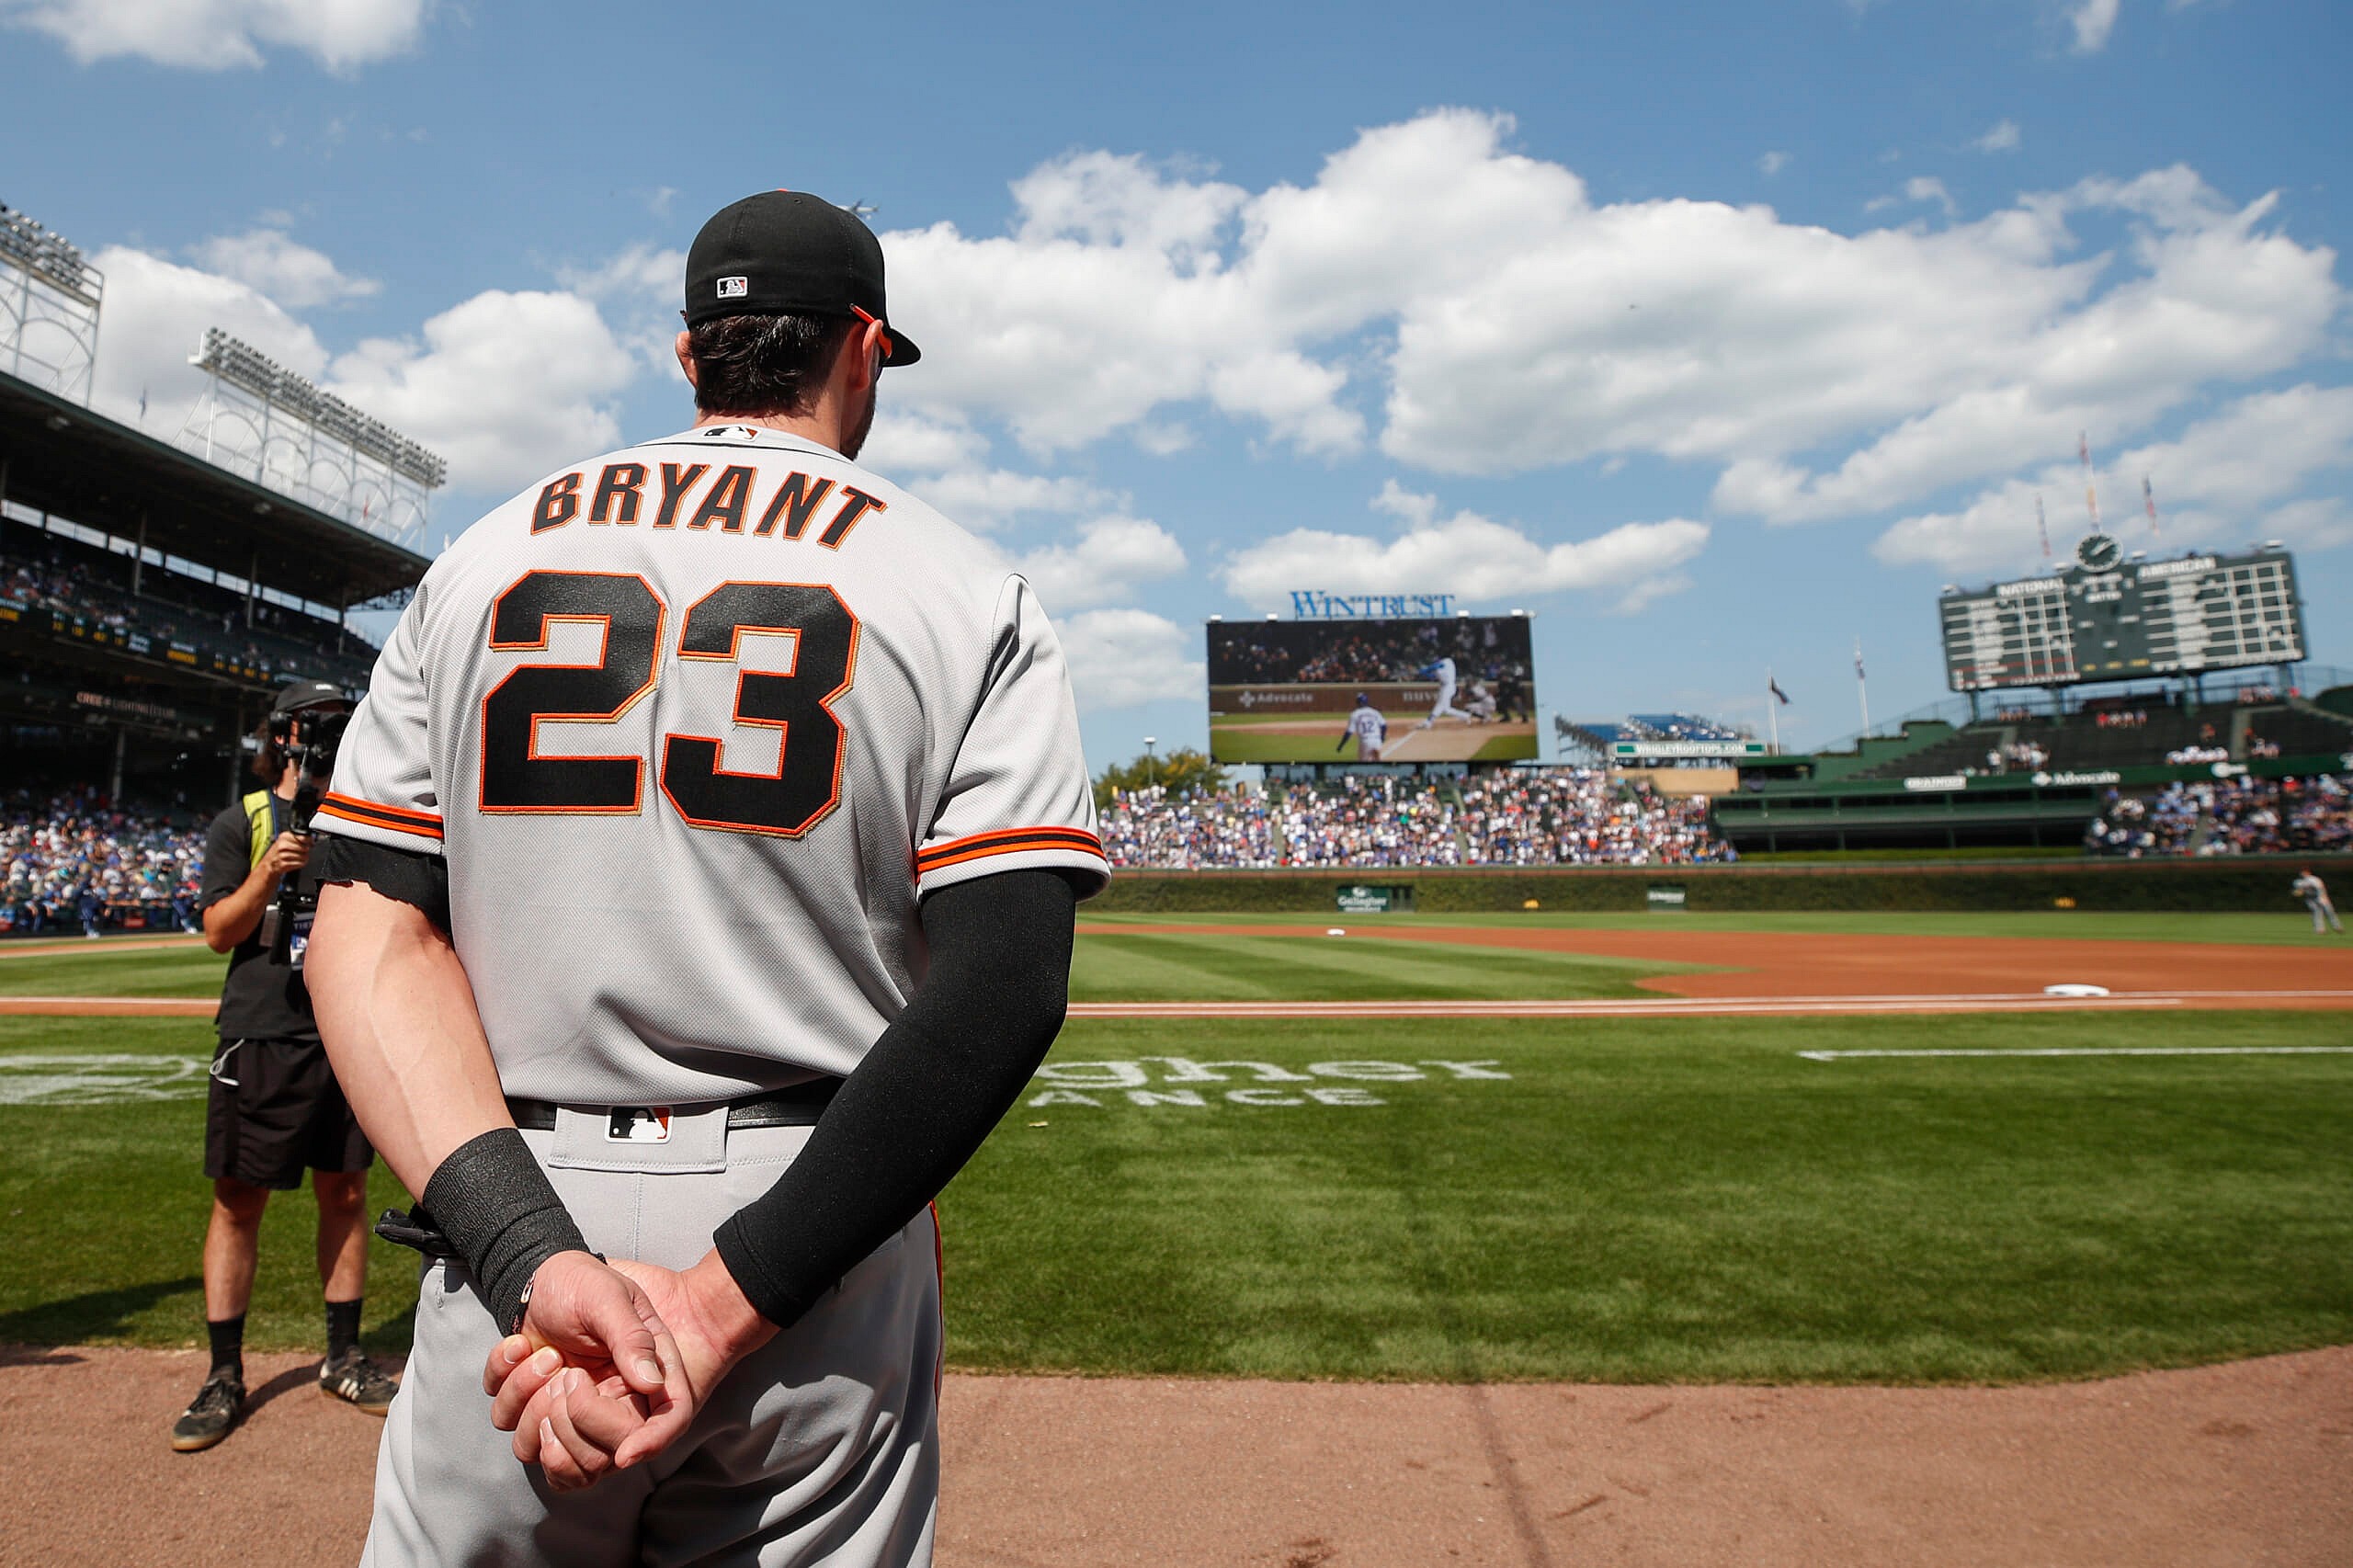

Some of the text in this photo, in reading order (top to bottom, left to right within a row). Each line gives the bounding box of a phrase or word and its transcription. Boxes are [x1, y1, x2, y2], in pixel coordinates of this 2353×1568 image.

[530, 461, 888, 551] BRYANT
[1290, 590, 1455, 618] WINTRUST
[479, 569, 863, 840] 23
[1256, 691, 1313, 703] Advocate
[1360, 721, 1376, 733] 12
[2054, 770, 2120, 786] Advocate
